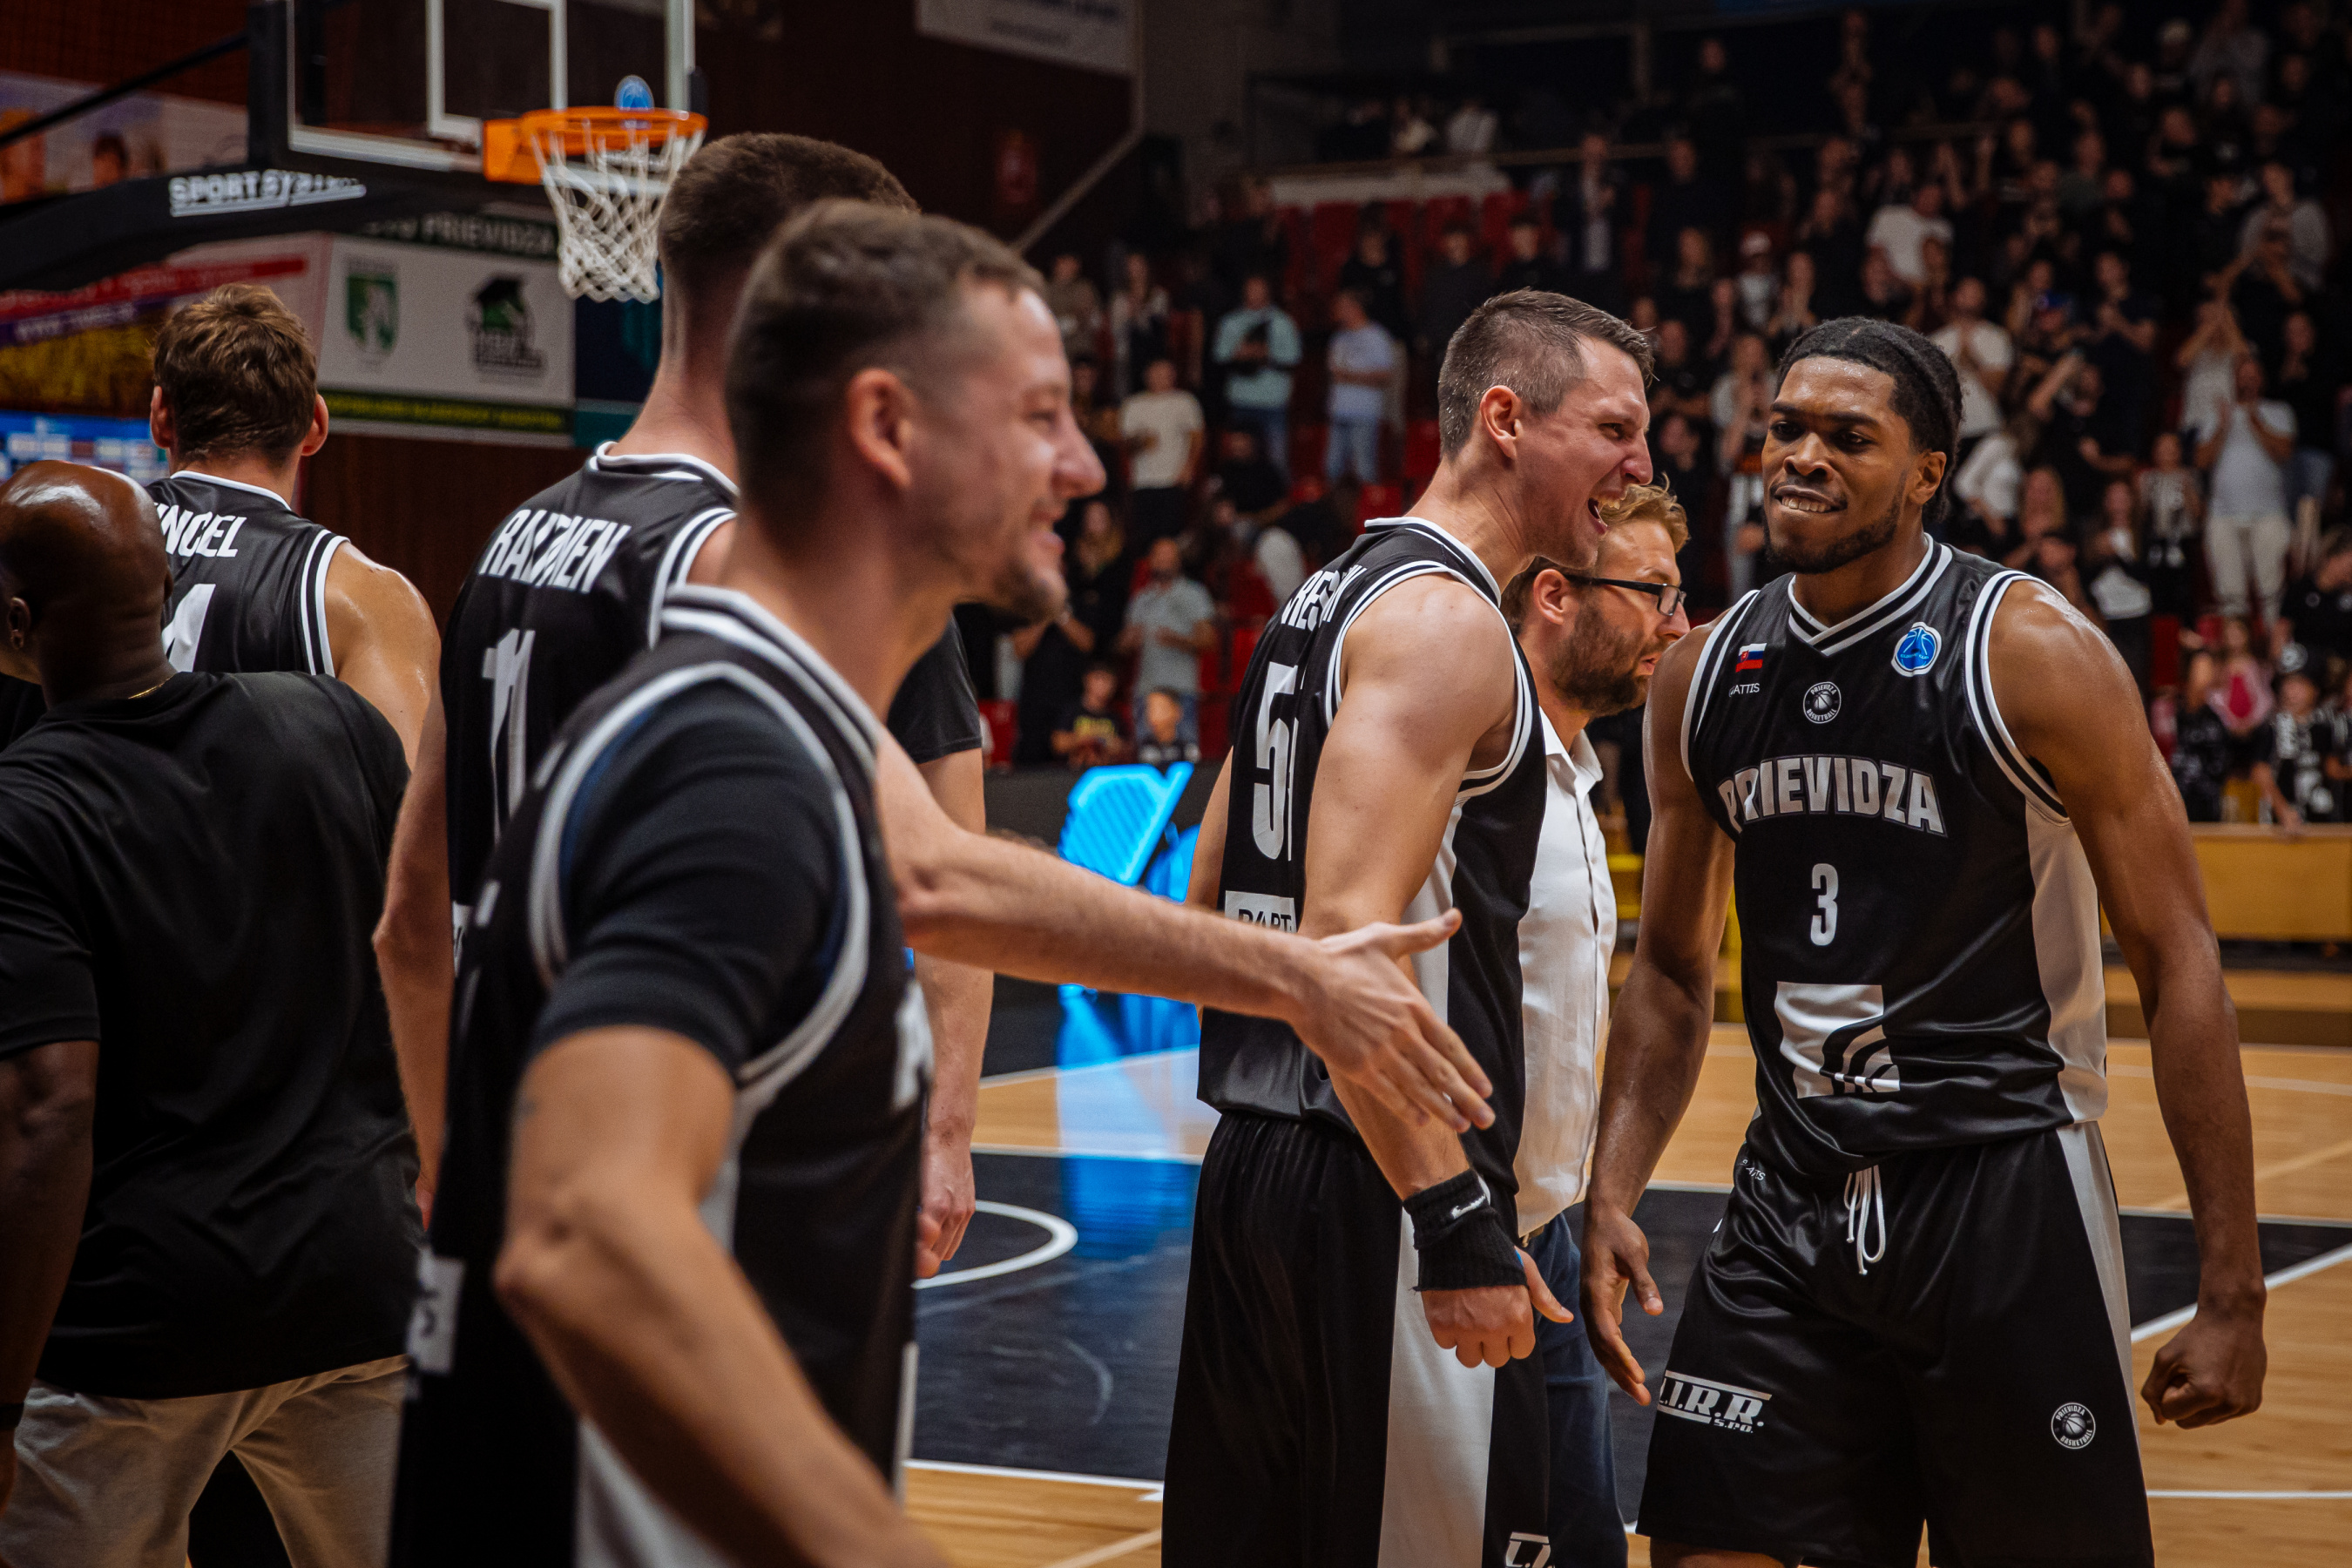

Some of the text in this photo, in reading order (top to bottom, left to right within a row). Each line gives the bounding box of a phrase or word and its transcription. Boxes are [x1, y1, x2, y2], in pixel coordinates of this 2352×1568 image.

[1717, 754, 1947, 836] PRIEVIDZA
[1810, 862, 1839, 946] 3
[2055, 1405, 2085, 1421] PRIEVIDZA
[2060, 1429, 2092, 1447] BASKETBALL
